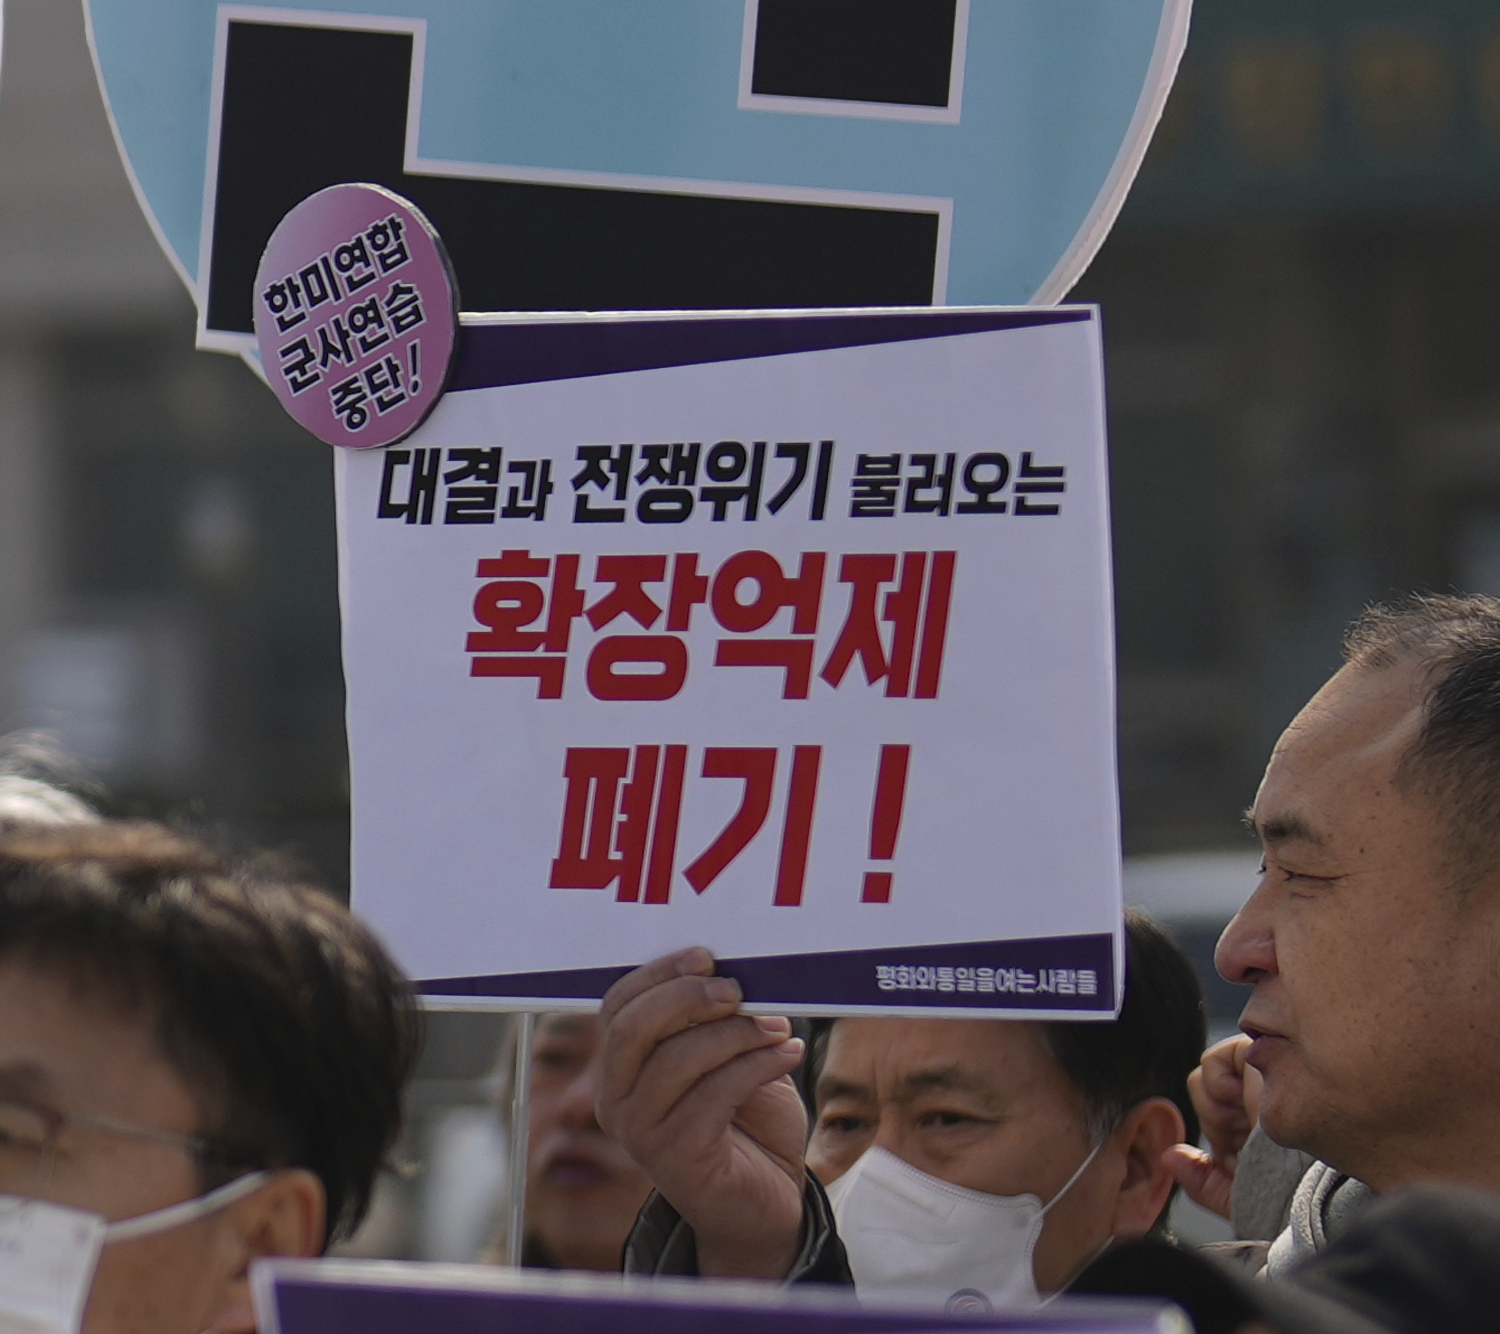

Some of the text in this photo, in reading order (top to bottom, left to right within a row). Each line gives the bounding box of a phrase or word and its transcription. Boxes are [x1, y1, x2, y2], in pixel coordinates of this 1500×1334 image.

[263, 214, 411, 334] 한미연합
[277, 280, 426, 396] 군사연습
[329, 340, 421, 431] 중단!
[376, 440, 1066, 526] 대결과 전쟁위기 불러오는
[464, 549, 958, 702] 확장억제
[875, 965, 1098, 995] 평화와통일을여는사람들
